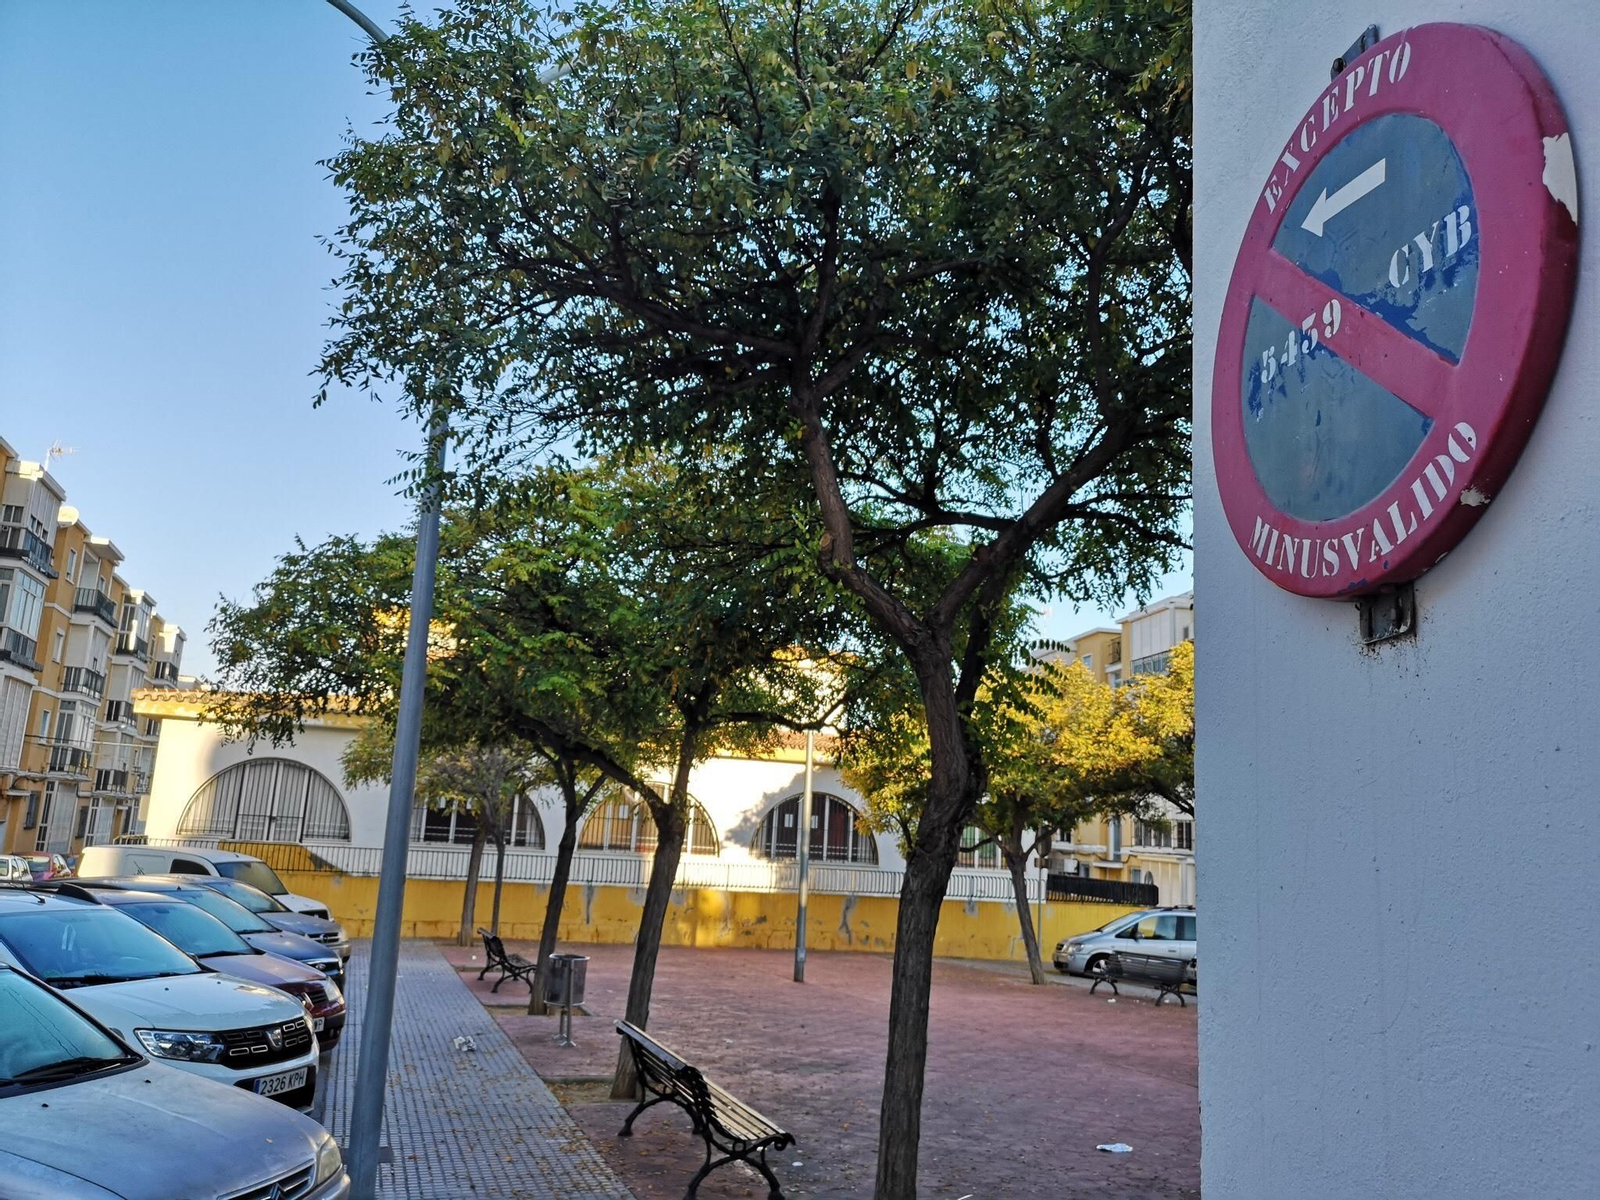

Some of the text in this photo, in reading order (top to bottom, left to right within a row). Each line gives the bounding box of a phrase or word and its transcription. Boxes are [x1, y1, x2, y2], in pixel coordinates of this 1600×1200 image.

[1264, 42, 1411, 214] EXCEPTO
[1389, 205, 1471, 288] CYB
[1261, 299, 1341, 384] 5459
[1248, 422, 1477, 578] MINUSVALIDO
[260, 1070, 305, 1095] 2326 KPH
